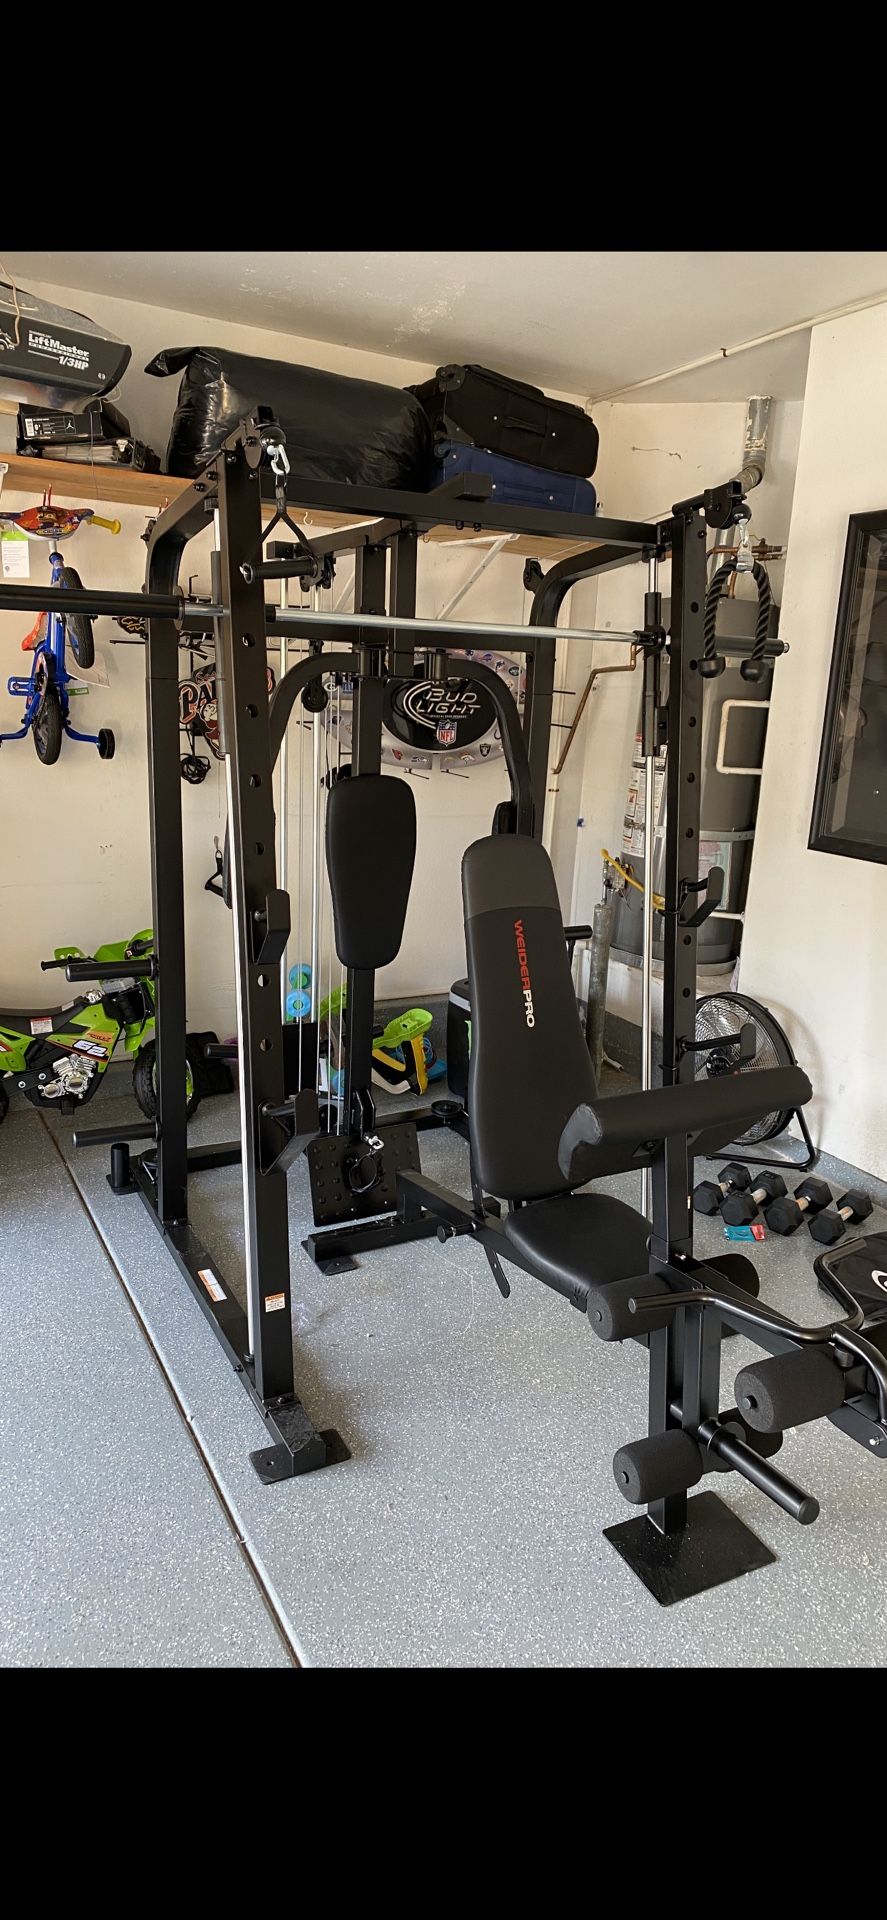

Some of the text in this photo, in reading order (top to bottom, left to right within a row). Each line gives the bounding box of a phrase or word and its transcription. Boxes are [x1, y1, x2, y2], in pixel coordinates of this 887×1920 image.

[28, 333, 90, 357] LiftMaster
[59, 355, 89, 370] 1/3HP
[425, 688, 477, 703] BUD
[416, 700, 481, 714] LIGHT
[440, 730, 455, 740] NFL
